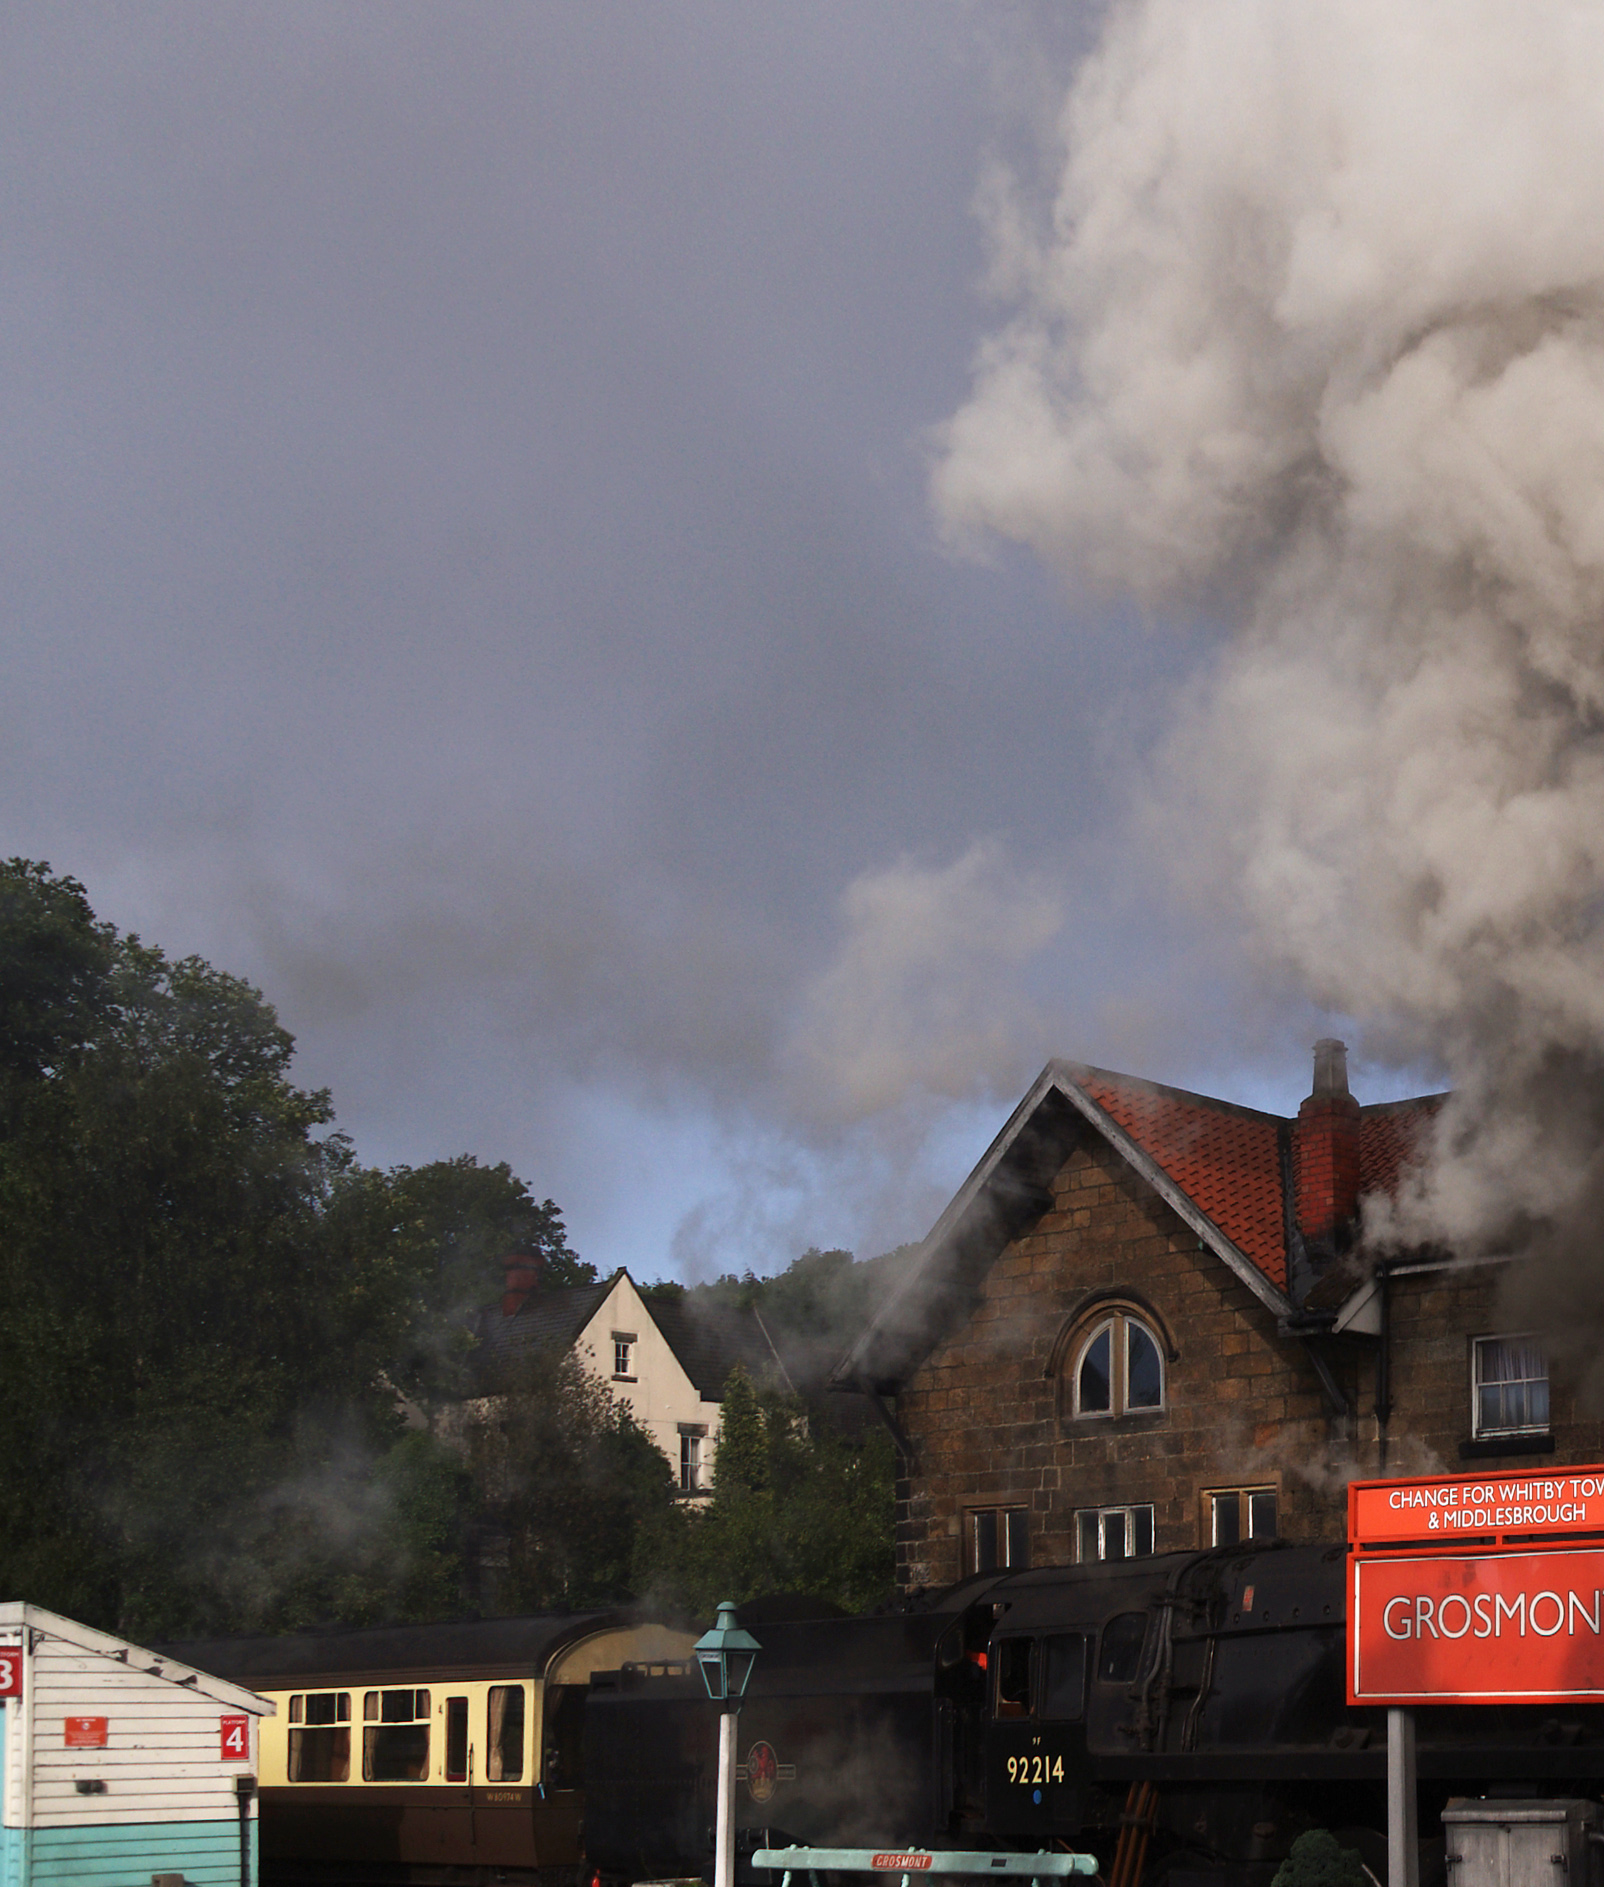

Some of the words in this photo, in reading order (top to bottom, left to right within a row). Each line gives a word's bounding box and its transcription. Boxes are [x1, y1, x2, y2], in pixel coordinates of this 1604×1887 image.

[1388, 1487, 1458, 1509] CHANGE
[1462, 1485, 1495, 1505] FOR
[1498, 1480, 1566, 1502] WHITBY
[1427, 1511, 1440, 1530] &
[1443, 1502, 1587, 1529] MIDDLESBROUGH
[0, 1659, 13, 1690] 3
[226, 1725, 244, 1753] 4
[1006, 1754, 1065, 1784] 92214
[876, 1855, 928, 1868] GROSMONT
